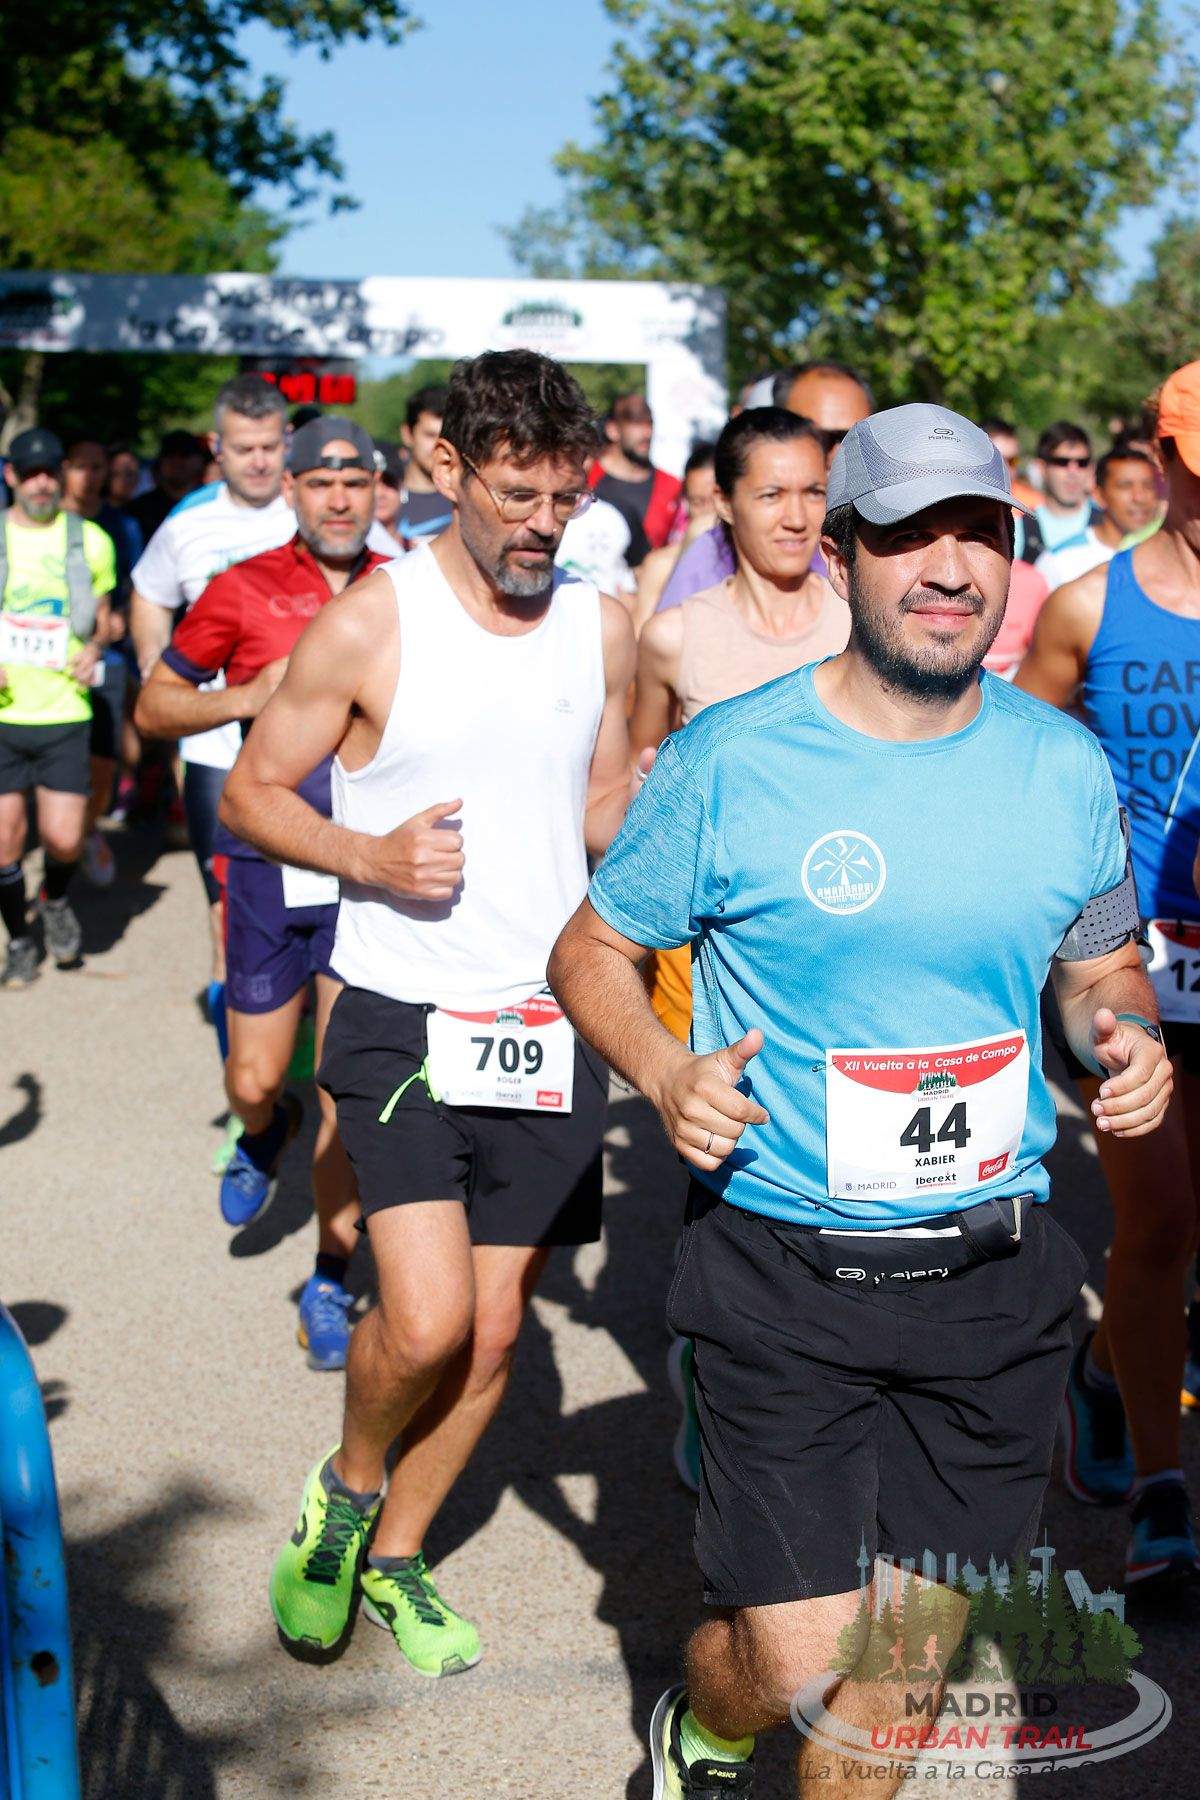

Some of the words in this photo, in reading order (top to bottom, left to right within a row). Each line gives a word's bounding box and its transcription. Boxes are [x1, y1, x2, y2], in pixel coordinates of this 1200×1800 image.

[470, 1036, 543, 1075] 709
[844, 1061, 860, 1071] XII
[863, 1060, 903, 1071] Vuelta
[917, 1060, 929, 1069] la
[934, 1055, 963, 1068] Casa
[965, 1052, 979, 1064] de
[981, 1045, 1017, 1061] Campo
[923, 1088, 949, 1096] MADRID
[900, 1101, 971, 1153] 44
[915, 1154, 956, 1168] XABIER
[915, 1171, 957, 1185] Iberext
[857, 1181, 897, 1191] MADRID
